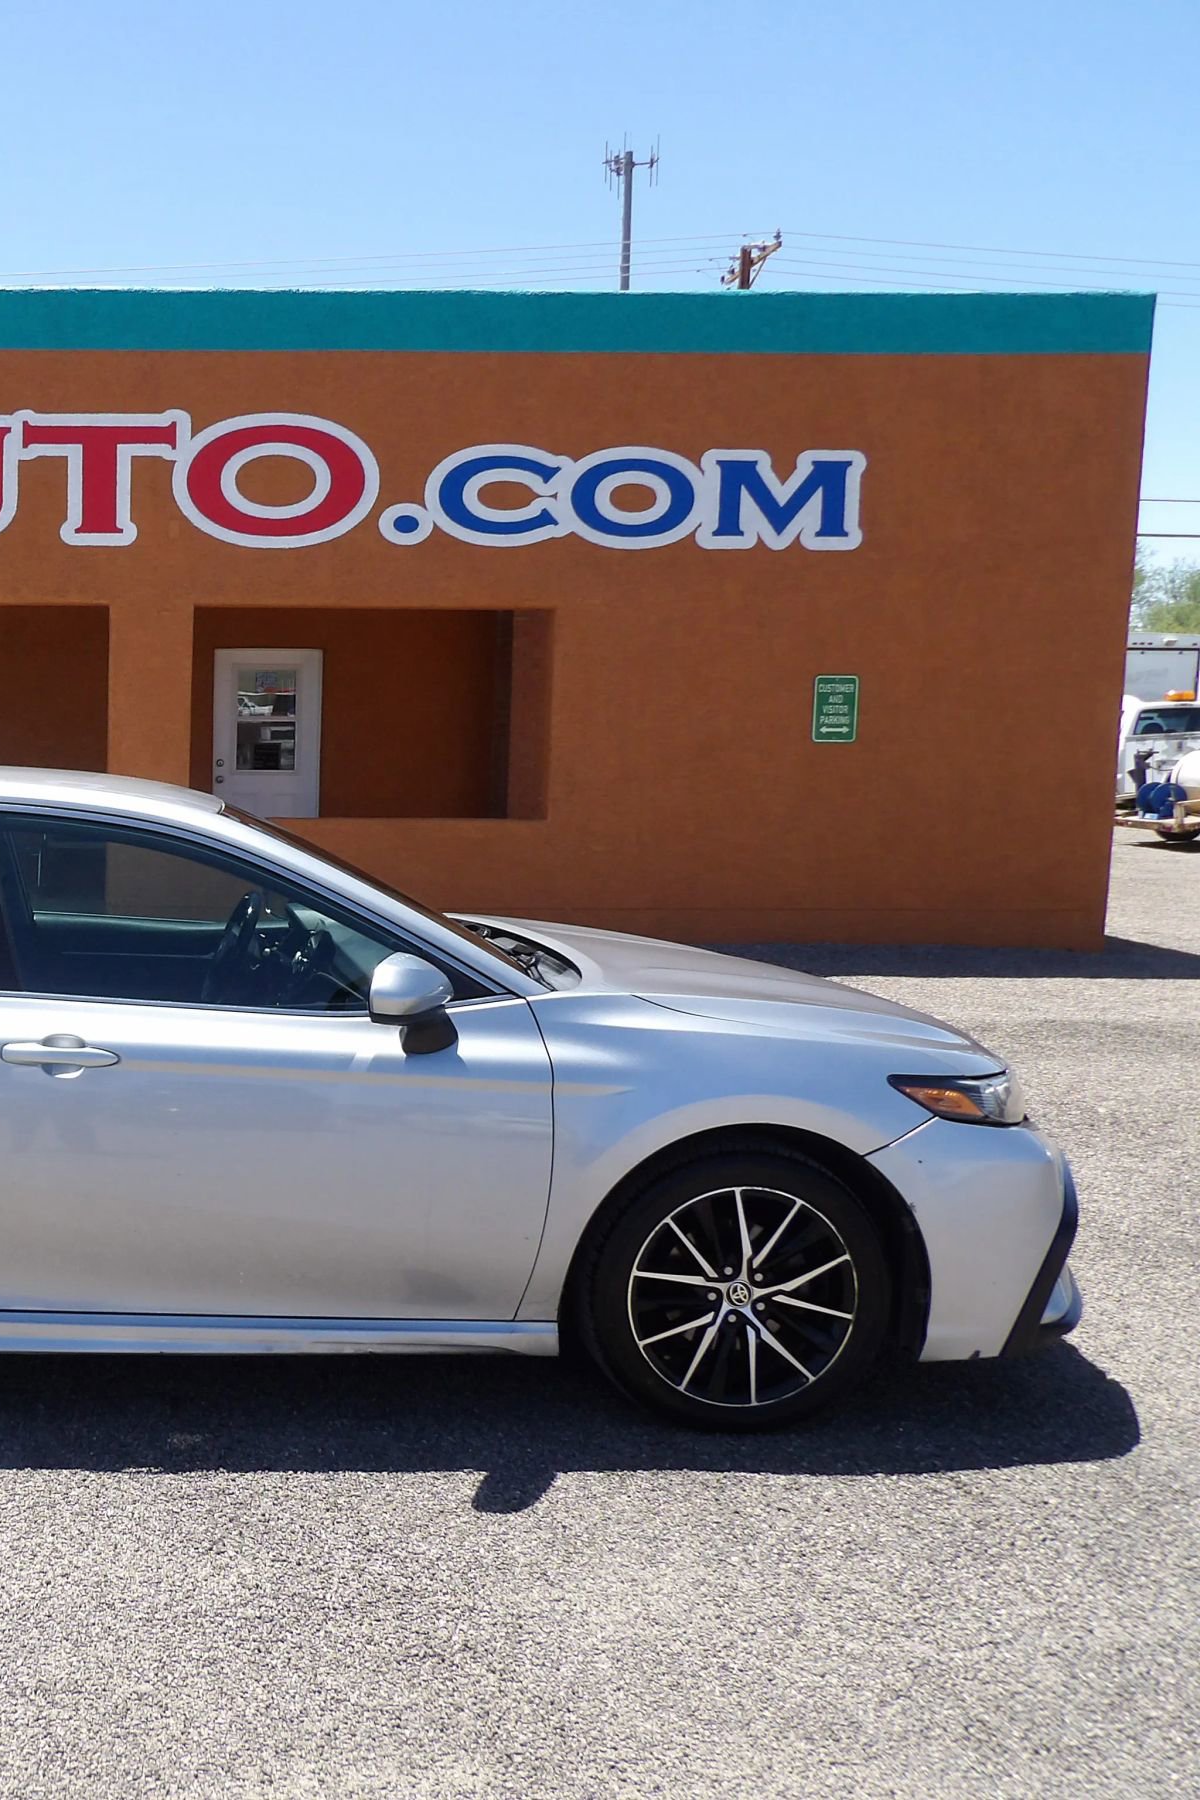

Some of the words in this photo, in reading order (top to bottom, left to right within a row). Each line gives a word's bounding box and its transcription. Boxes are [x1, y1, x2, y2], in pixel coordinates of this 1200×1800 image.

[818, 683, 855, 693] CUSTOMER
[828, 694, 844, 704] AND
[822, 705, 849, 714] VISITOR
[819, 715, 850, 725] PARKING
